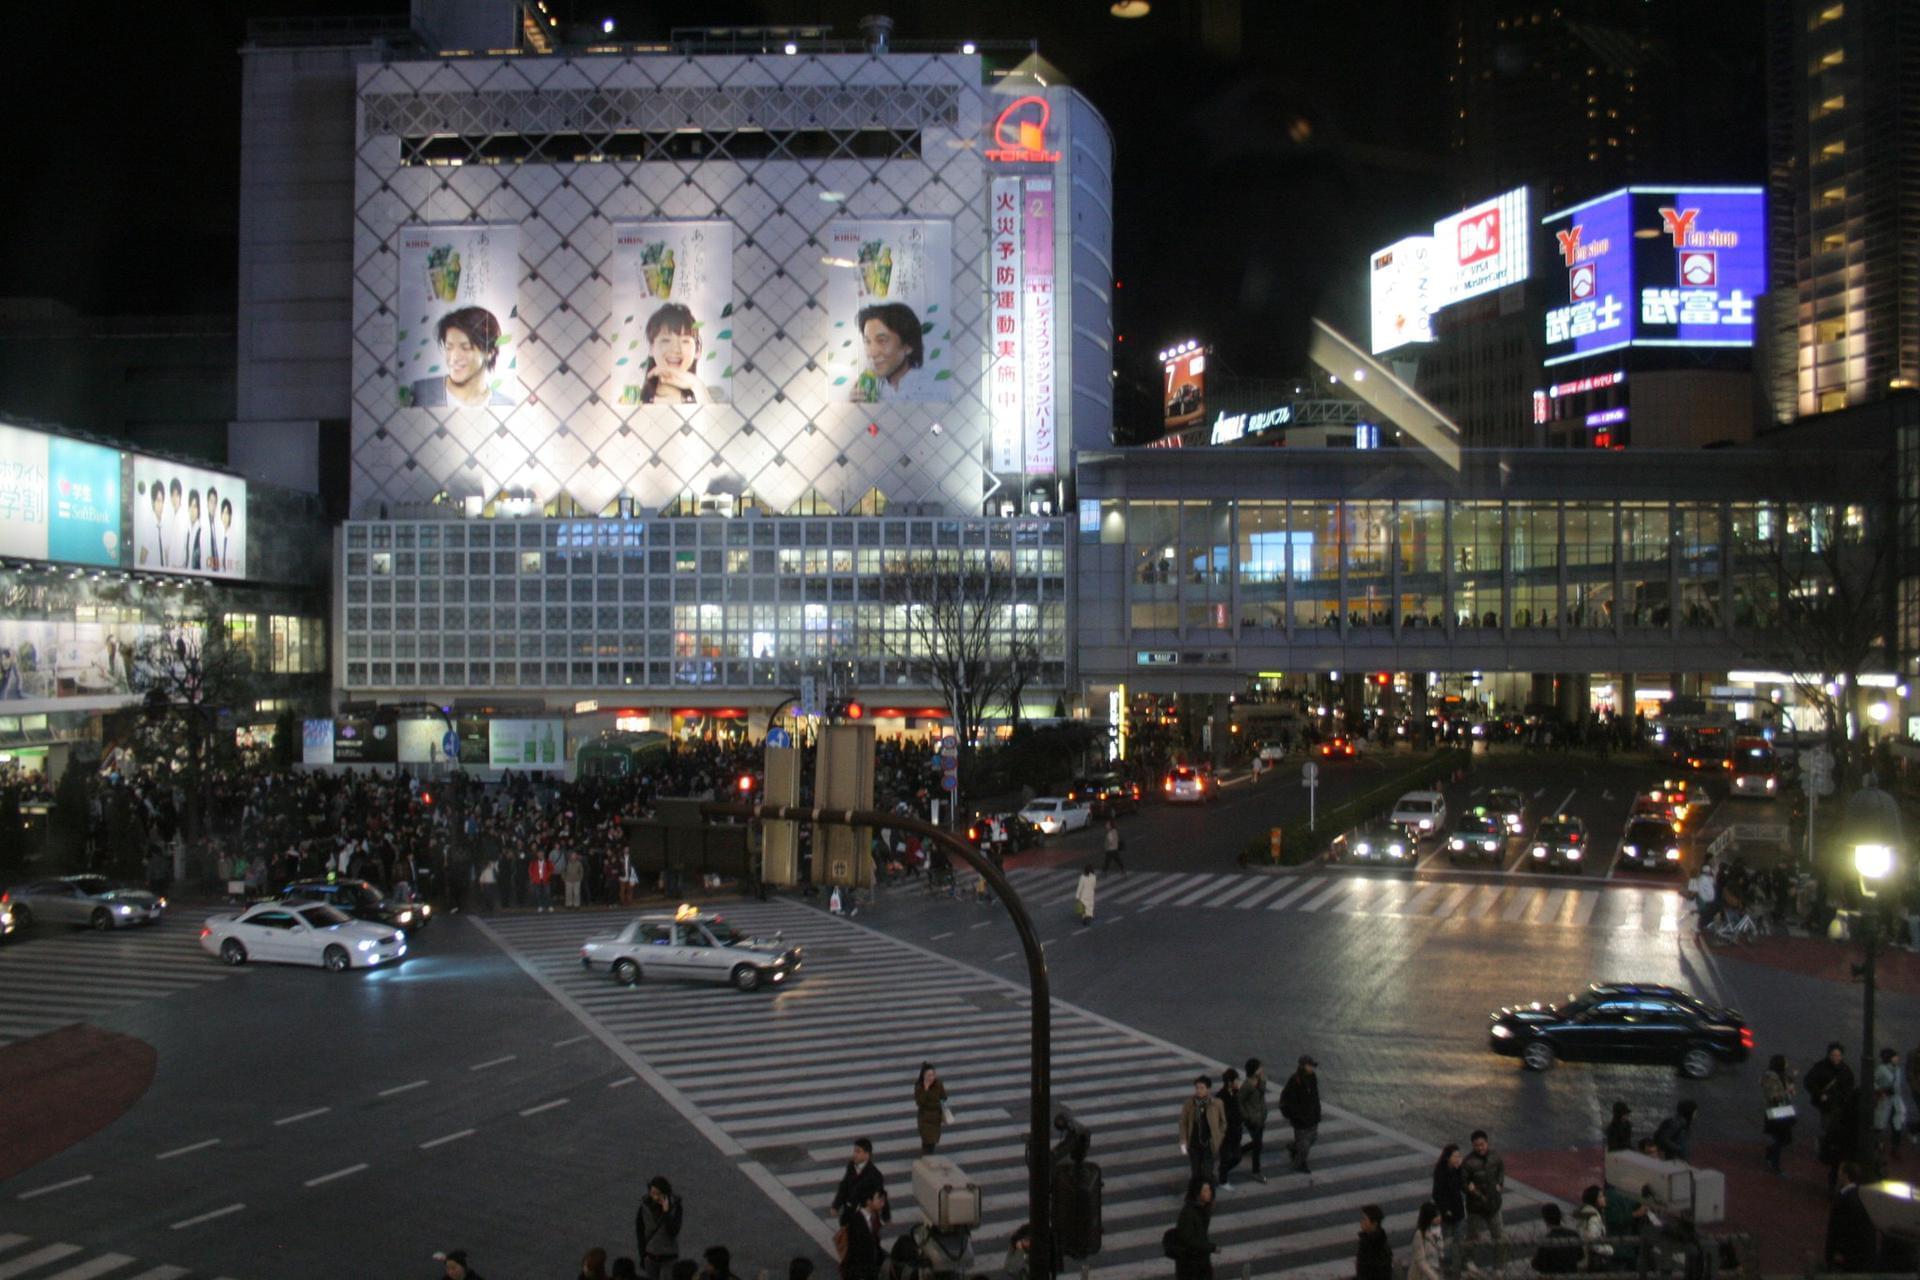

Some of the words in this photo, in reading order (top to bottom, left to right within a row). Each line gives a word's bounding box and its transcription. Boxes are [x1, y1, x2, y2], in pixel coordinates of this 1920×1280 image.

[985, 147, 1062, 162] TOKYU
[618, 237, 643, 245] KIRIN
[834, 234, 860, 242] KIRIN
[405, 240, 431, 248] KIRIN
[1642, 289, 1753, 325] 武富士
[1546, 294, 1623, 345] 武富士
